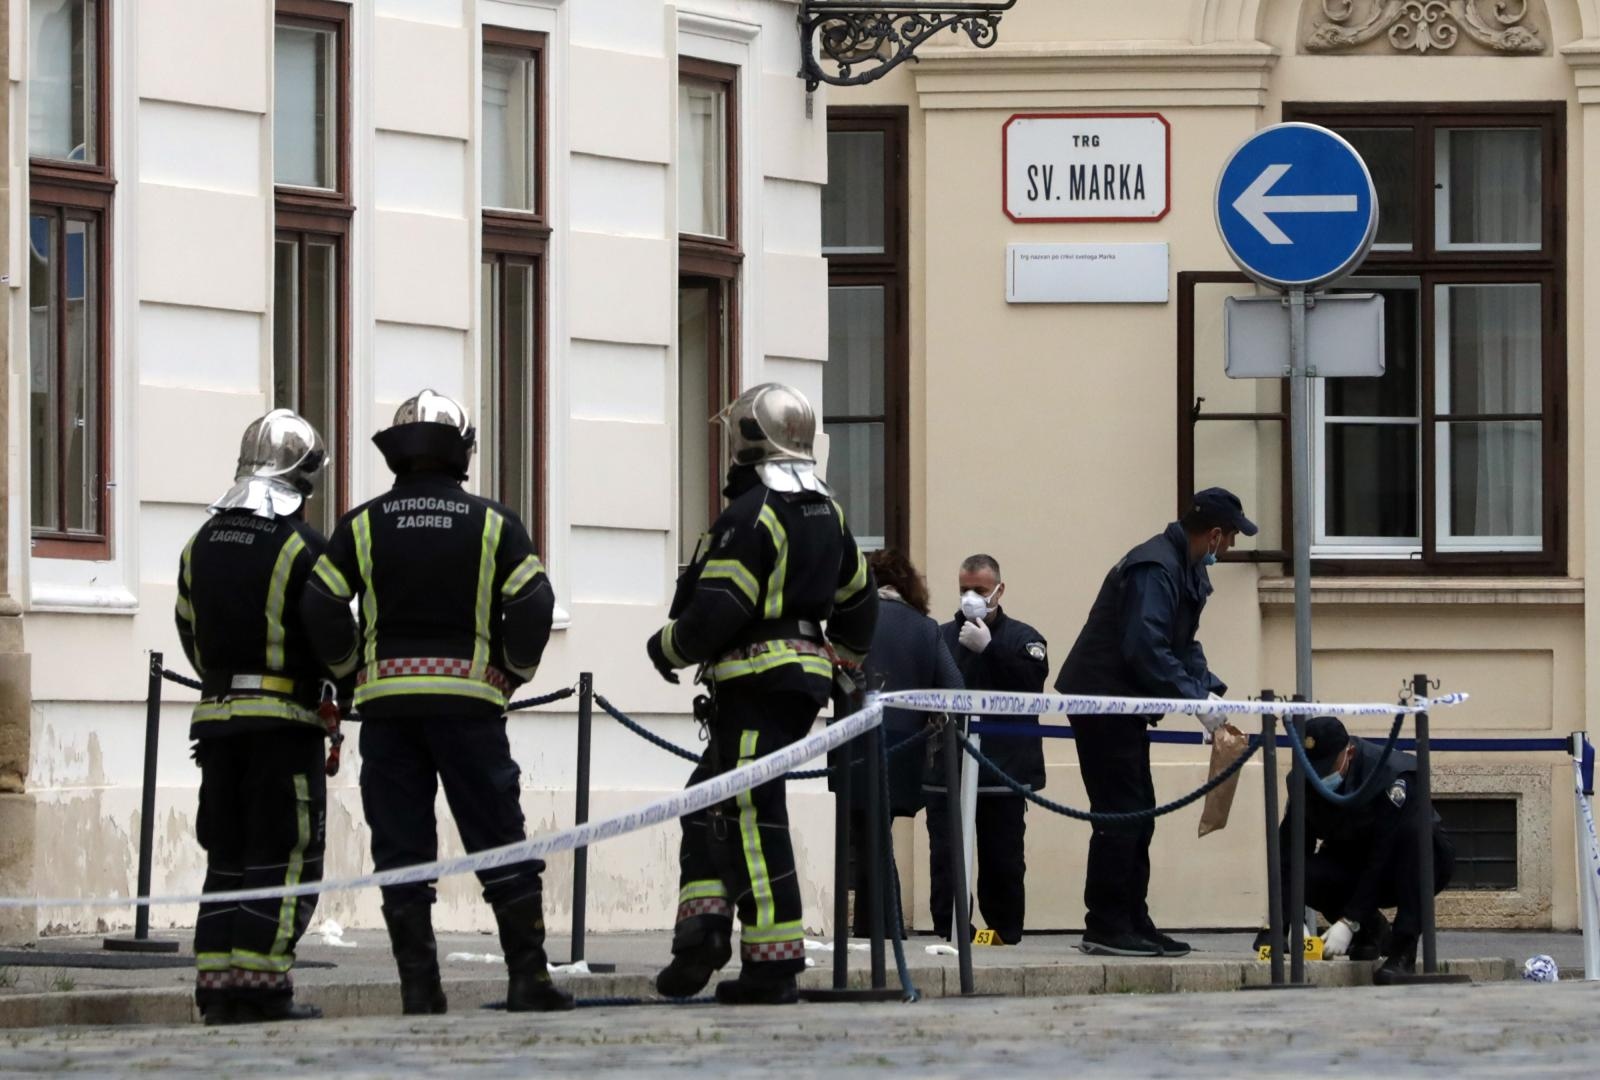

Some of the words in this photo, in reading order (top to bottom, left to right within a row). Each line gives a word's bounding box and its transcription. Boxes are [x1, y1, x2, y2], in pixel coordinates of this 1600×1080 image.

[1072, 135, 1100, 147] TRG
[1027, 164, 1061, 201] SV.
[1069, 163, 1146, 201] MARKA
[382, 497, 470, 515] VATROGASCI
[396, 515, 453, 529] ZAGREB
[209, 530, 255, 545] ZAGREB
[989, 695, 1027, 712] POLICIJA
[1028, 697, 1051, 713] STOP
[977, 931, 990, 944] 53
